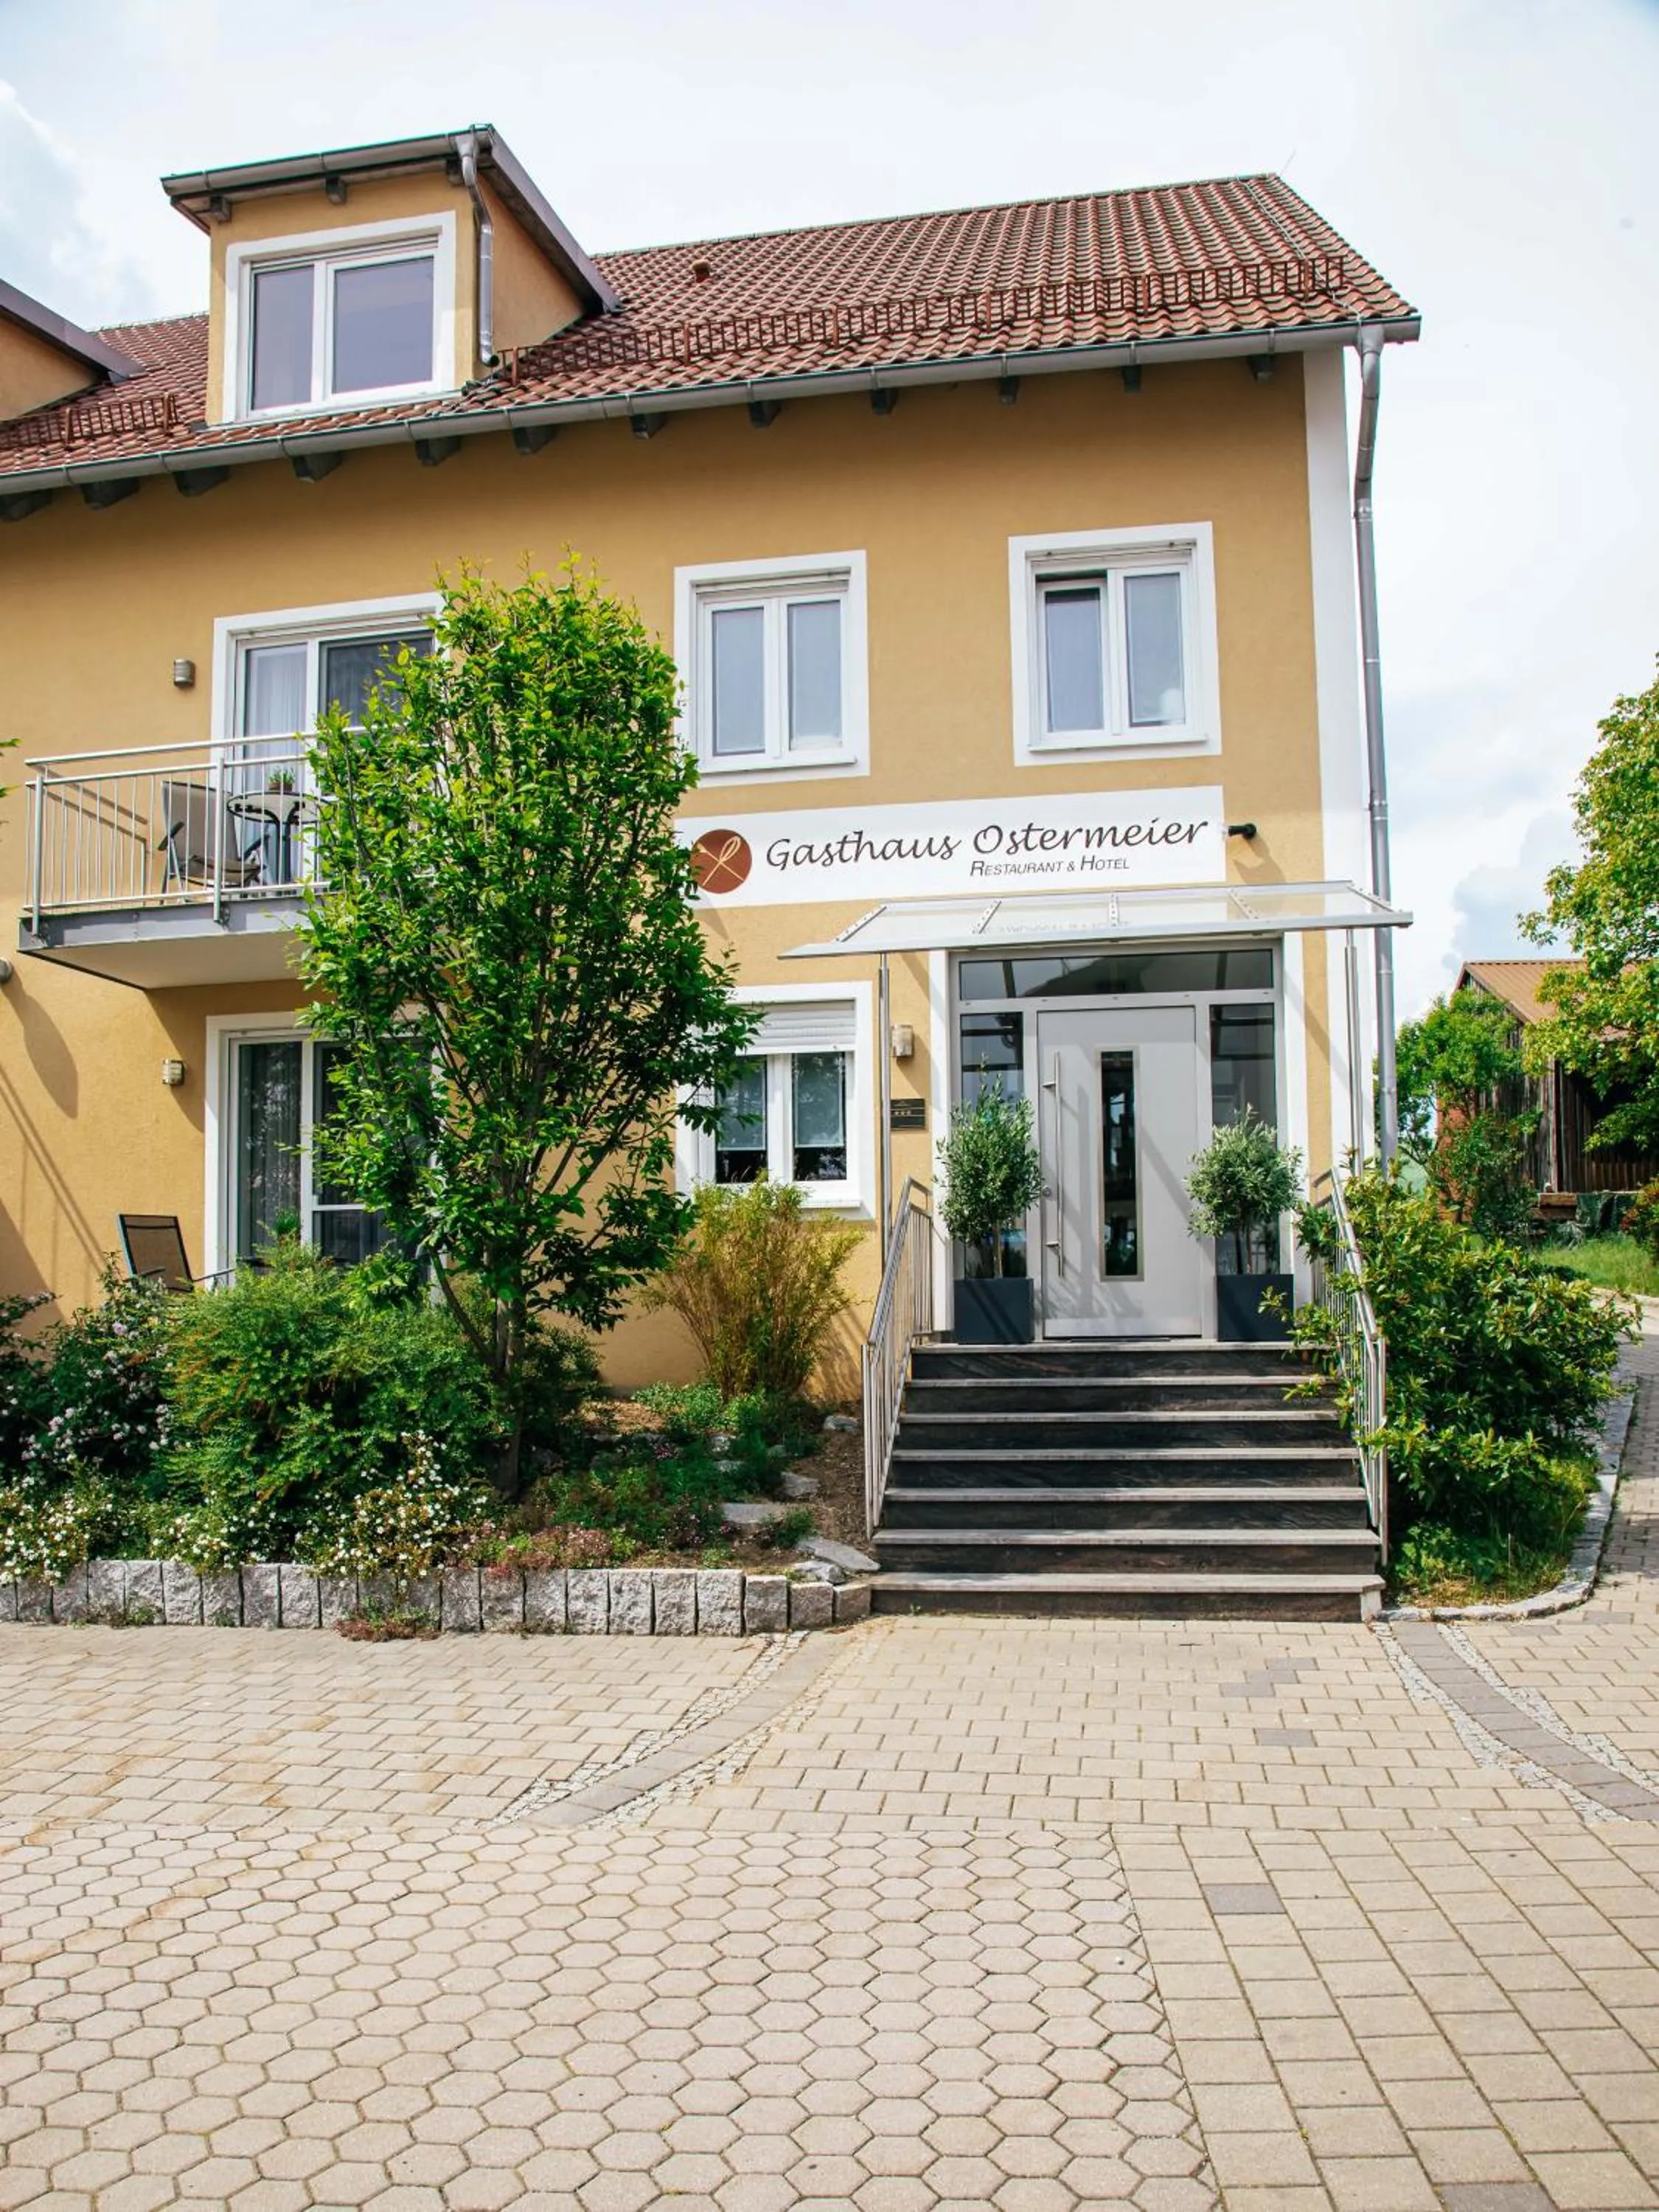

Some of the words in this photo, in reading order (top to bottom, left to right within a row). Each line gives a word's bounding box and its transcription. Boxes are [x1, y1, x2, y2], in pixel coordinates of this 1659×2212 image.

[766, 830, 962, 871] Gasthaus
[973, 817, 1208, 855] Ostermeier
[1067, 860, 1076, 872] &
